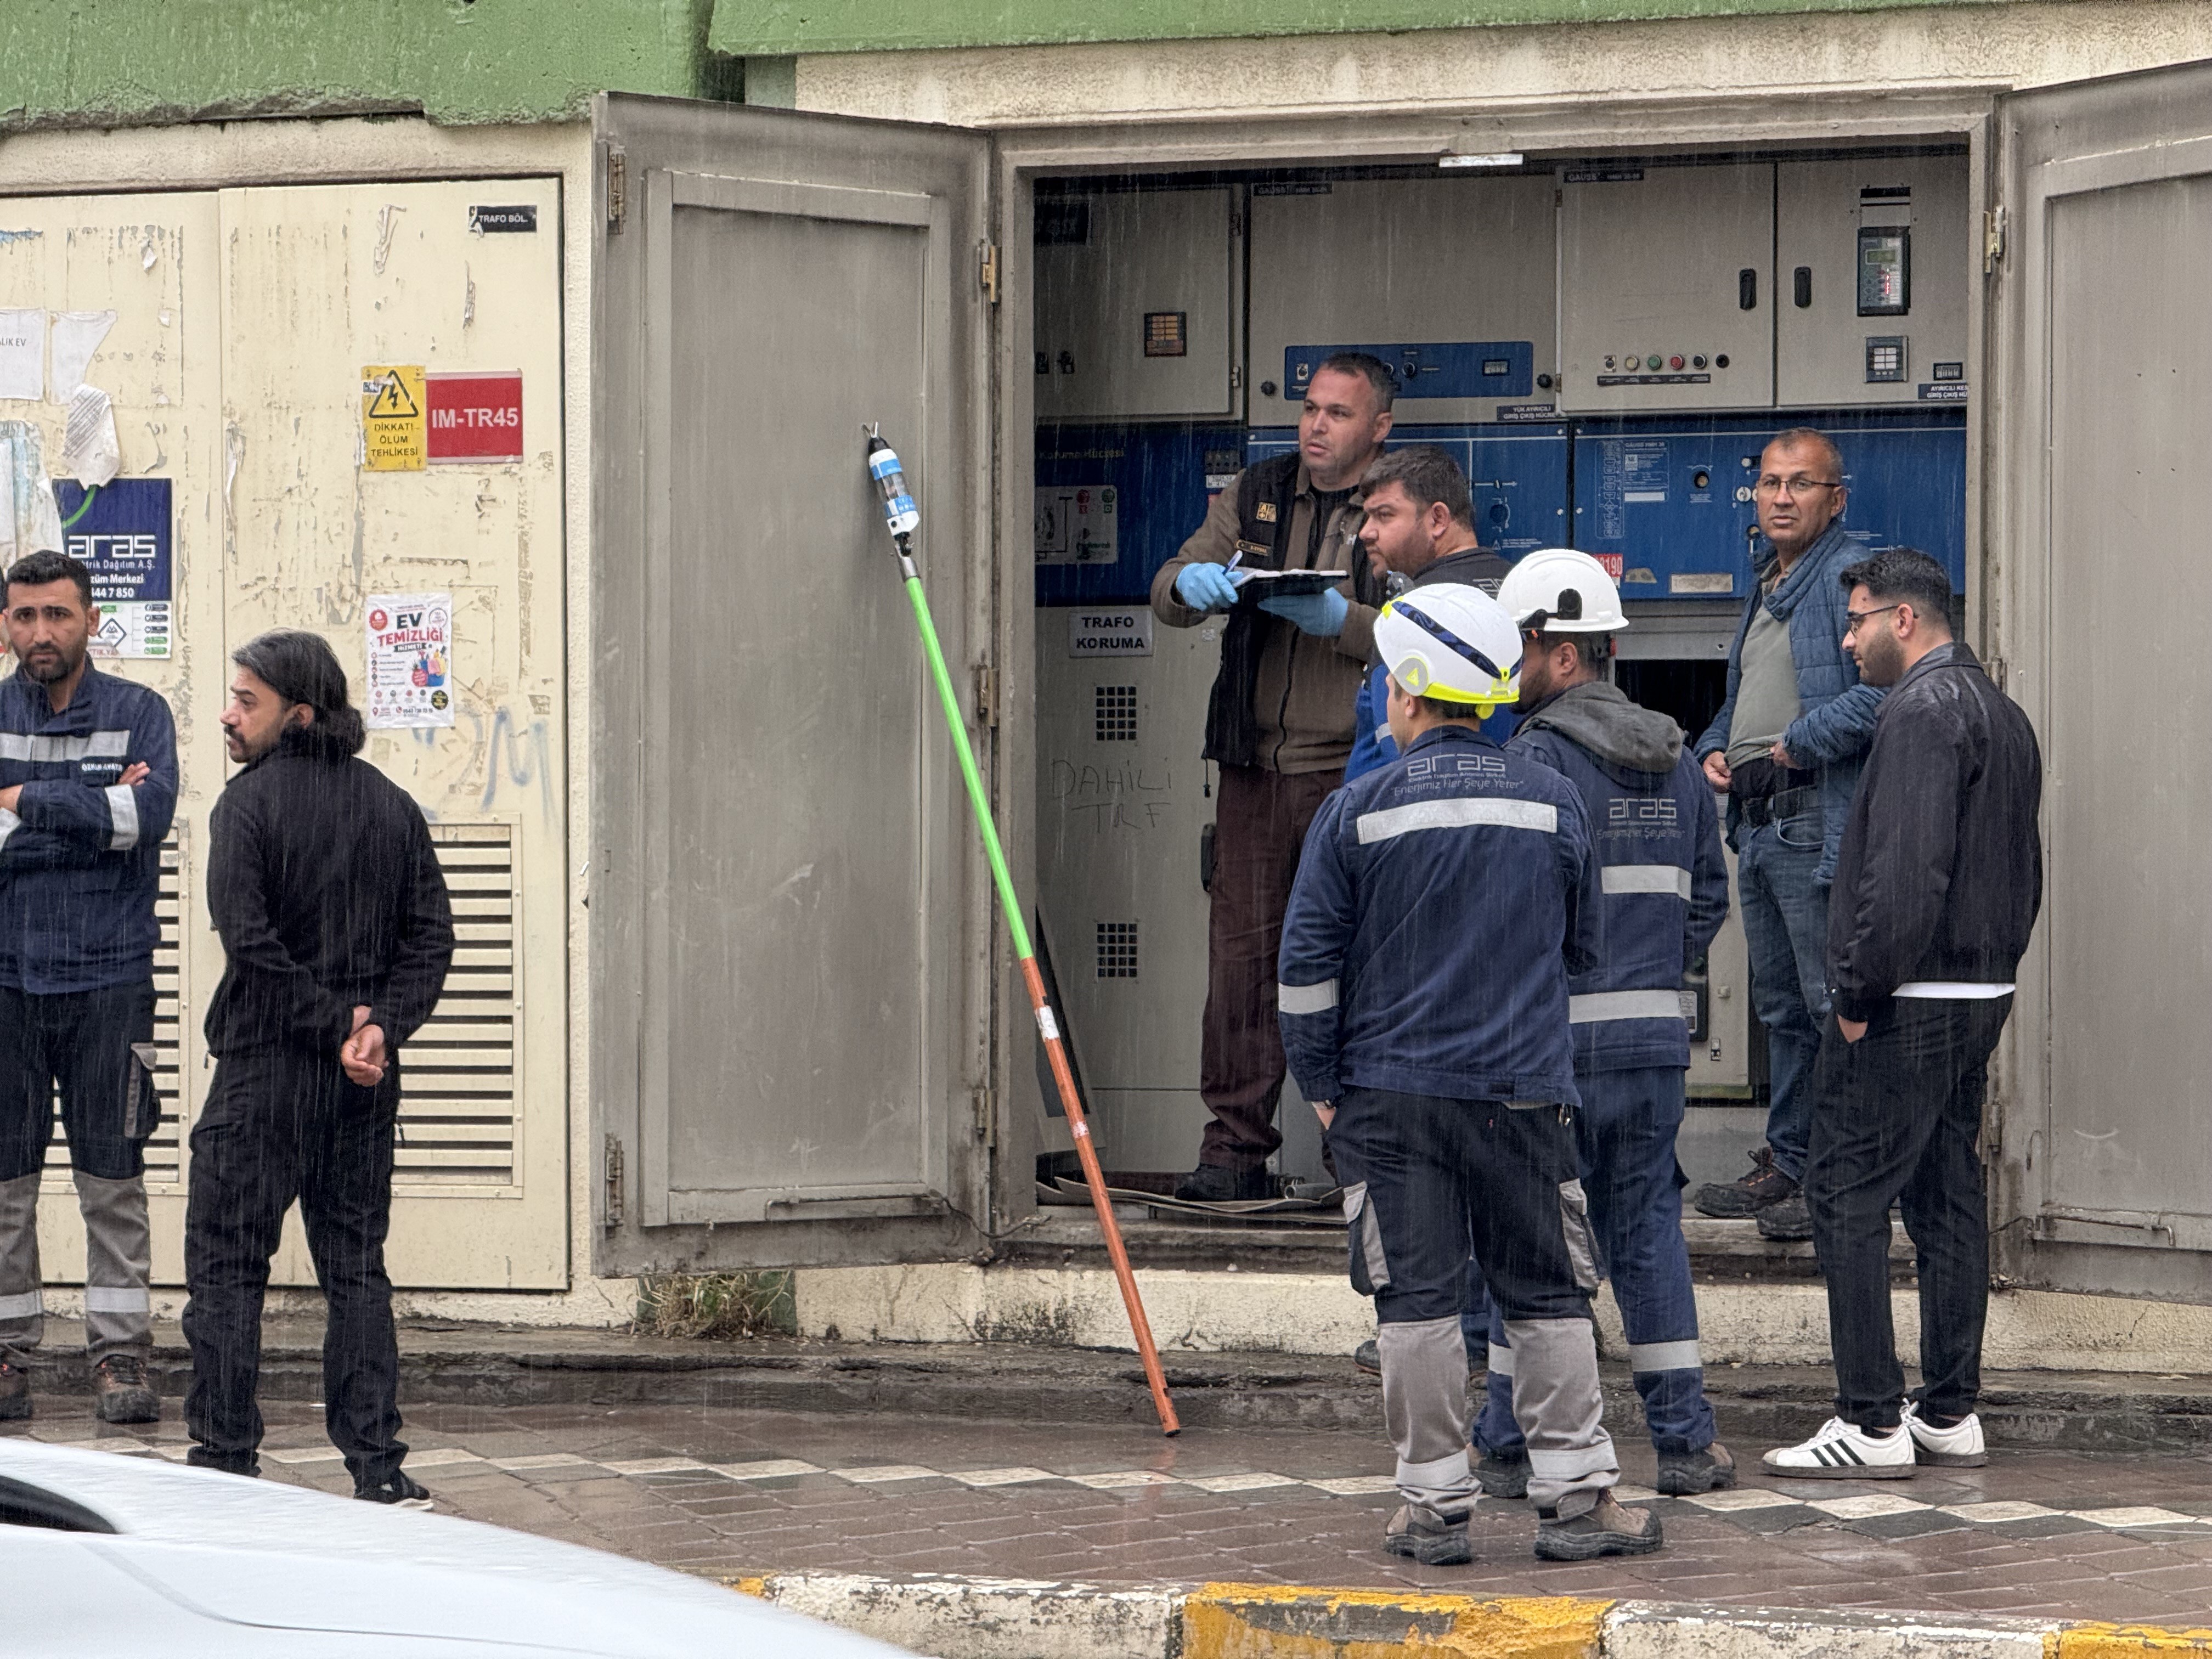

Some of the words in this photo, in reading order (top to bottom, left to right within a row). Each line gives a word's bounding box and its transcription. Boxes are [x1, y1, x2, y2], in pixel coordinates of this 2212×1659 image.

[478, 215, 506, 223] TRAFO
[432, 407, 518, 428] IM-TR45
[371, 447, 417, 457] TEHLİKESİ
[90, 573, 109, 584] züm
[108, 587, 115, 598] 7
[116, 587, 134, 598] 850
[397, 612, 422, 629] EV
[1081, 616, 1134, 628] TRAFO
[377, 627, 443, 647] TEMİZLİĞİ
[1076, 636, 1145, 649] KORUMA
[1443, 779, 1462, 788] Her
[1464, 777, 1491, 790] Şeye
